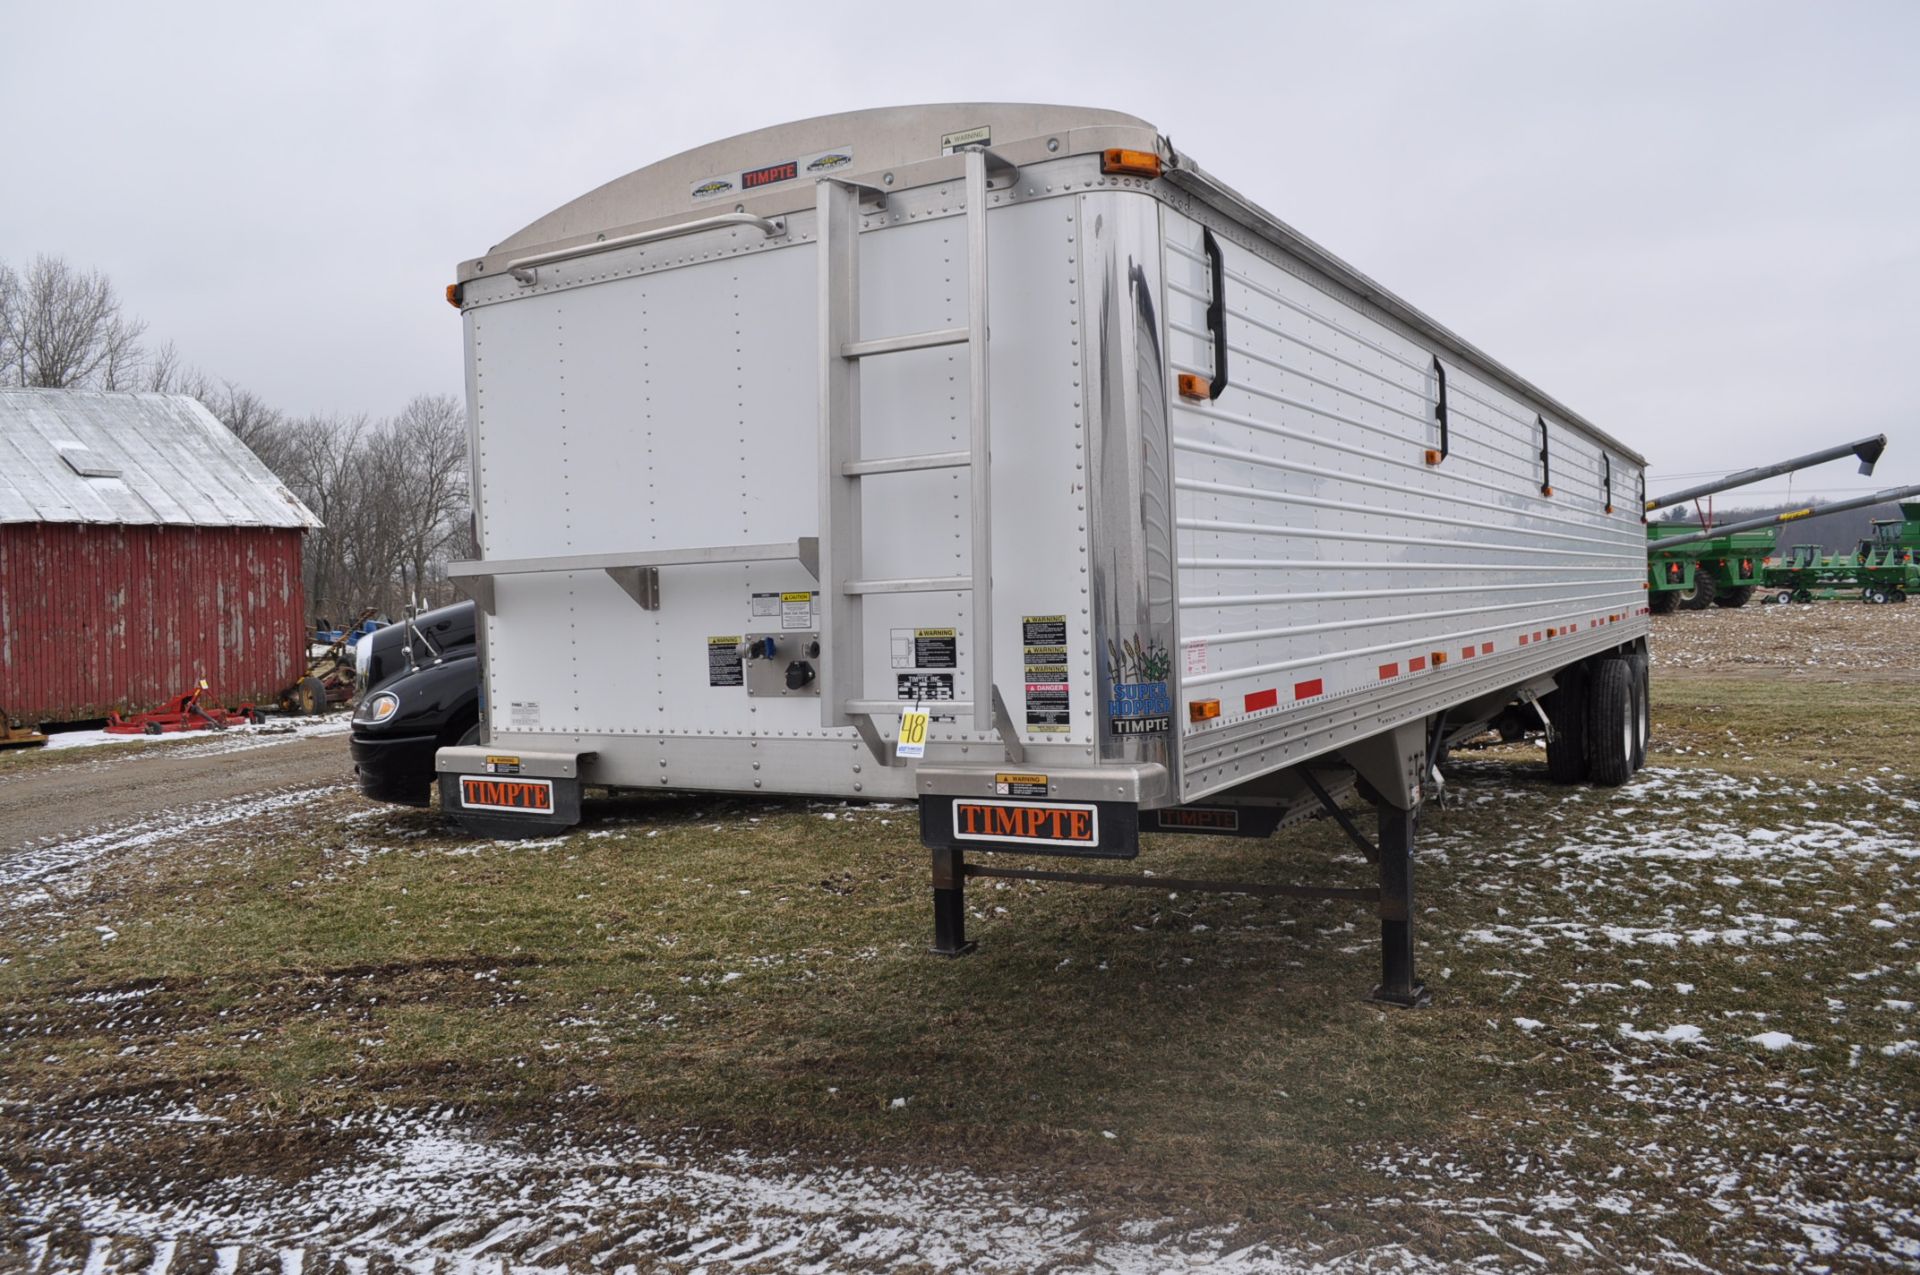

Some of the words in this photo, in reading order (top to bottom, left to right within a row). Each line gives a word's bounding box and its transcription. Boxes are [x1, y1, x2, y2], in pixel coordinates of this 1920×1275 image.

[954, 130, 983, 141] WARNING
[745, 165, 795, 187] TIMPTE
[923, 629, 953, 637] WARNING
[1114, 683, 1166, 699] SUPER
[901, 713, 926, 744] 48
[1115, 719, 1168, 732] TIMPTE
[464, 781, 548, 808] TIMPTE
[960, 805, 1092, 840] TIMPTE
[1162, 810, 1236, 828] TIMPTE
